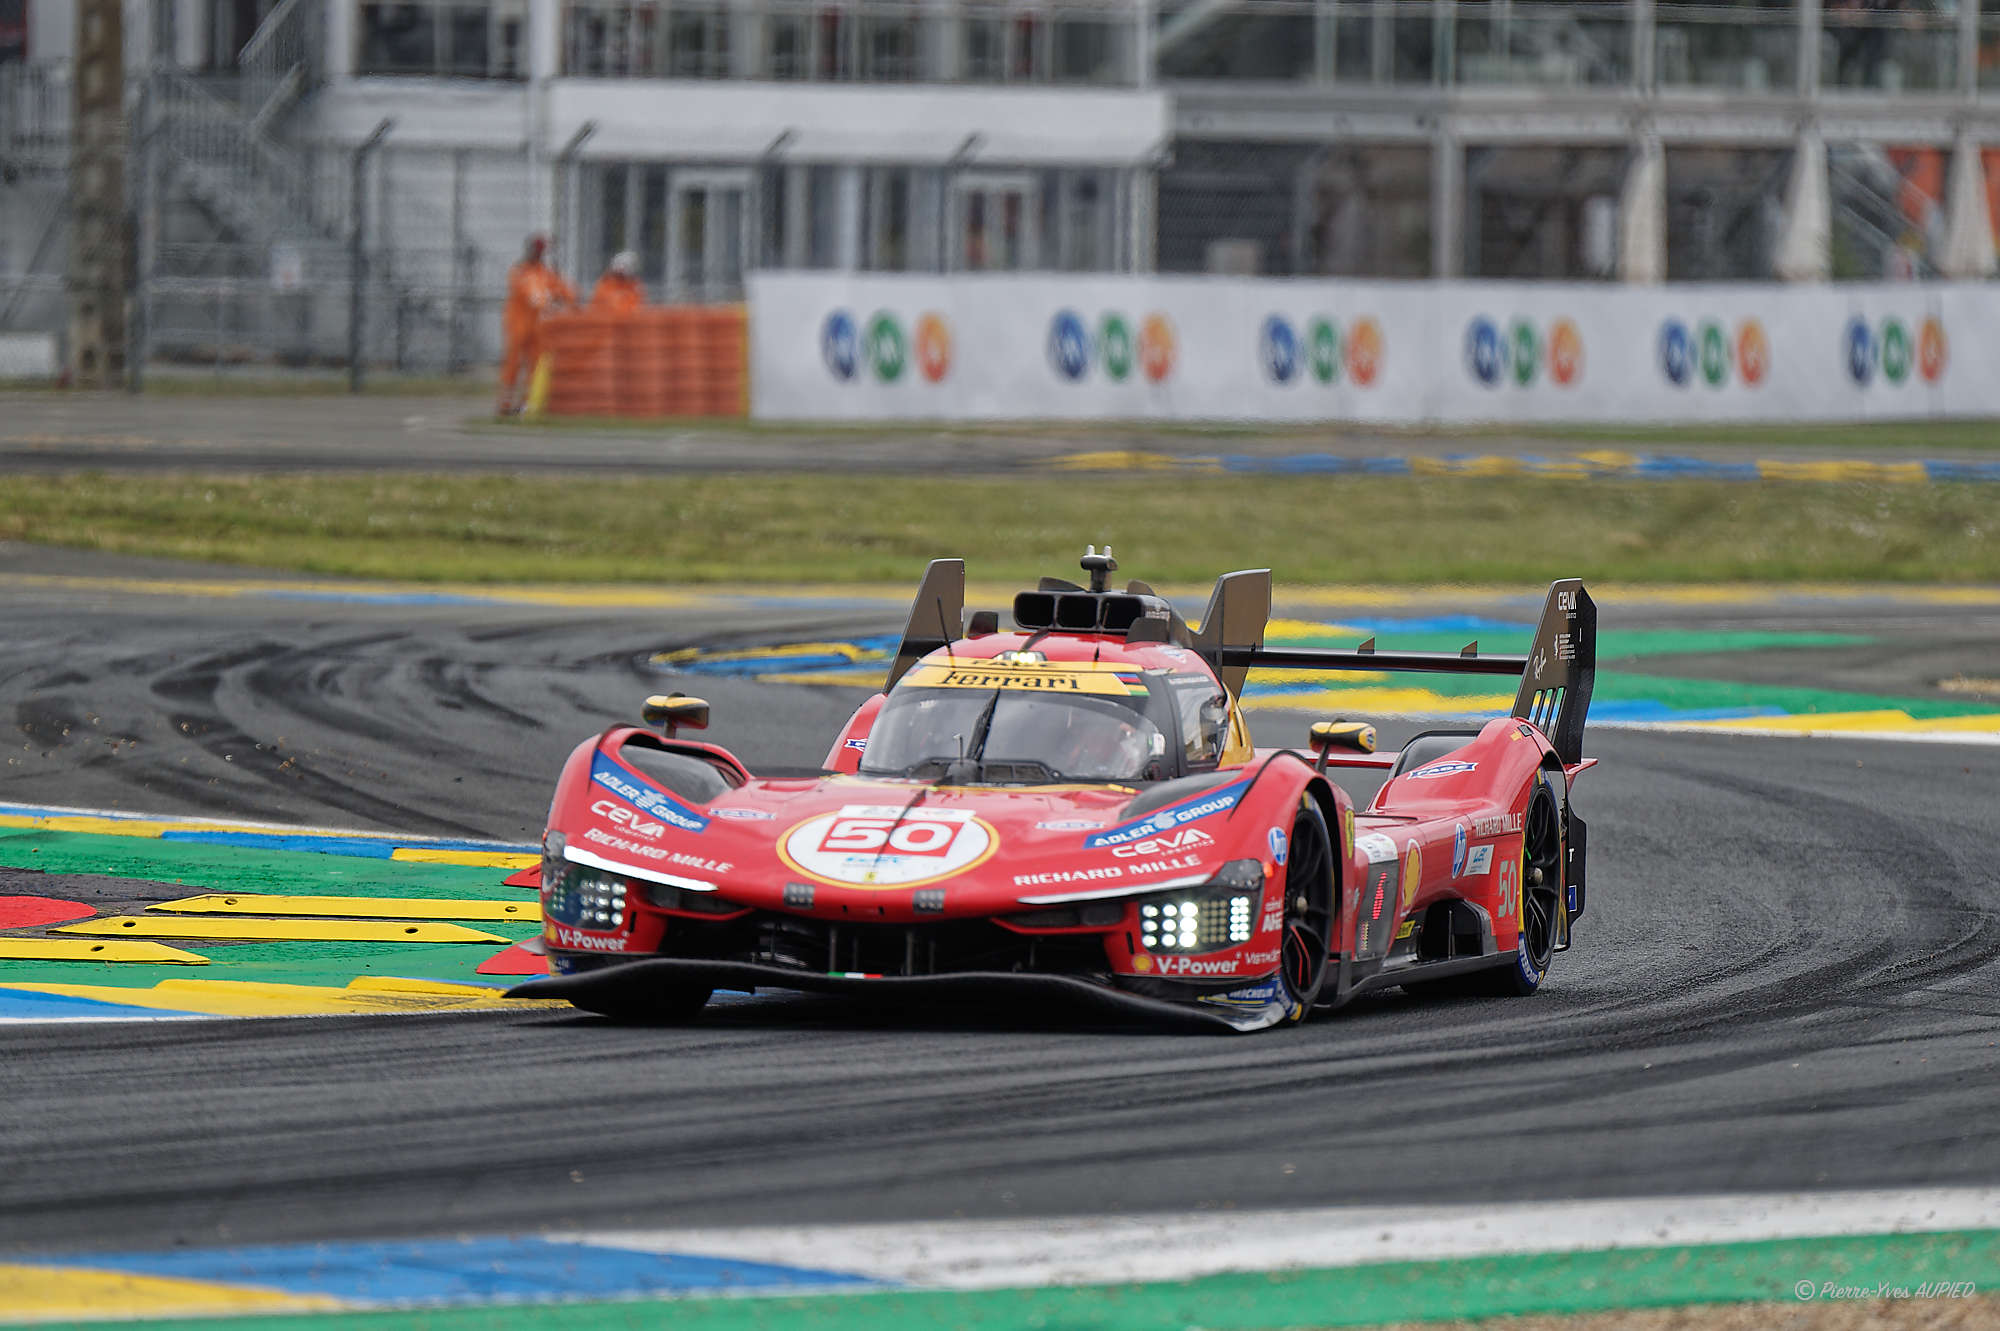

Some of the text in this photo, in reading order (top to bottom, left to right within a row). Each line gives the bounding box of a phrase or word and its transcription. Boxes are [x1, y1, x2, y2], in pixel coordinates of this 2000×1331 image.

[937, 671, 1081, 690] Ferrari
[593, 771, 641, 800] ADLER
[651, 804, 704, 829] GROUP
[825, 819, 953, 852] 50
[1094, 824, 1156, 846] ADLER
[1175, 796, 1235, 821] GROUP
[583, 828, 735, 874] RICHARD MILLE
[1013, 854, 1202, 886] RICHARD MILLE
[1498, 860, 1517, 918] 50
[559, 928, 628, 951] V-Power
[1157, 957, 1239, 974] V-Power
